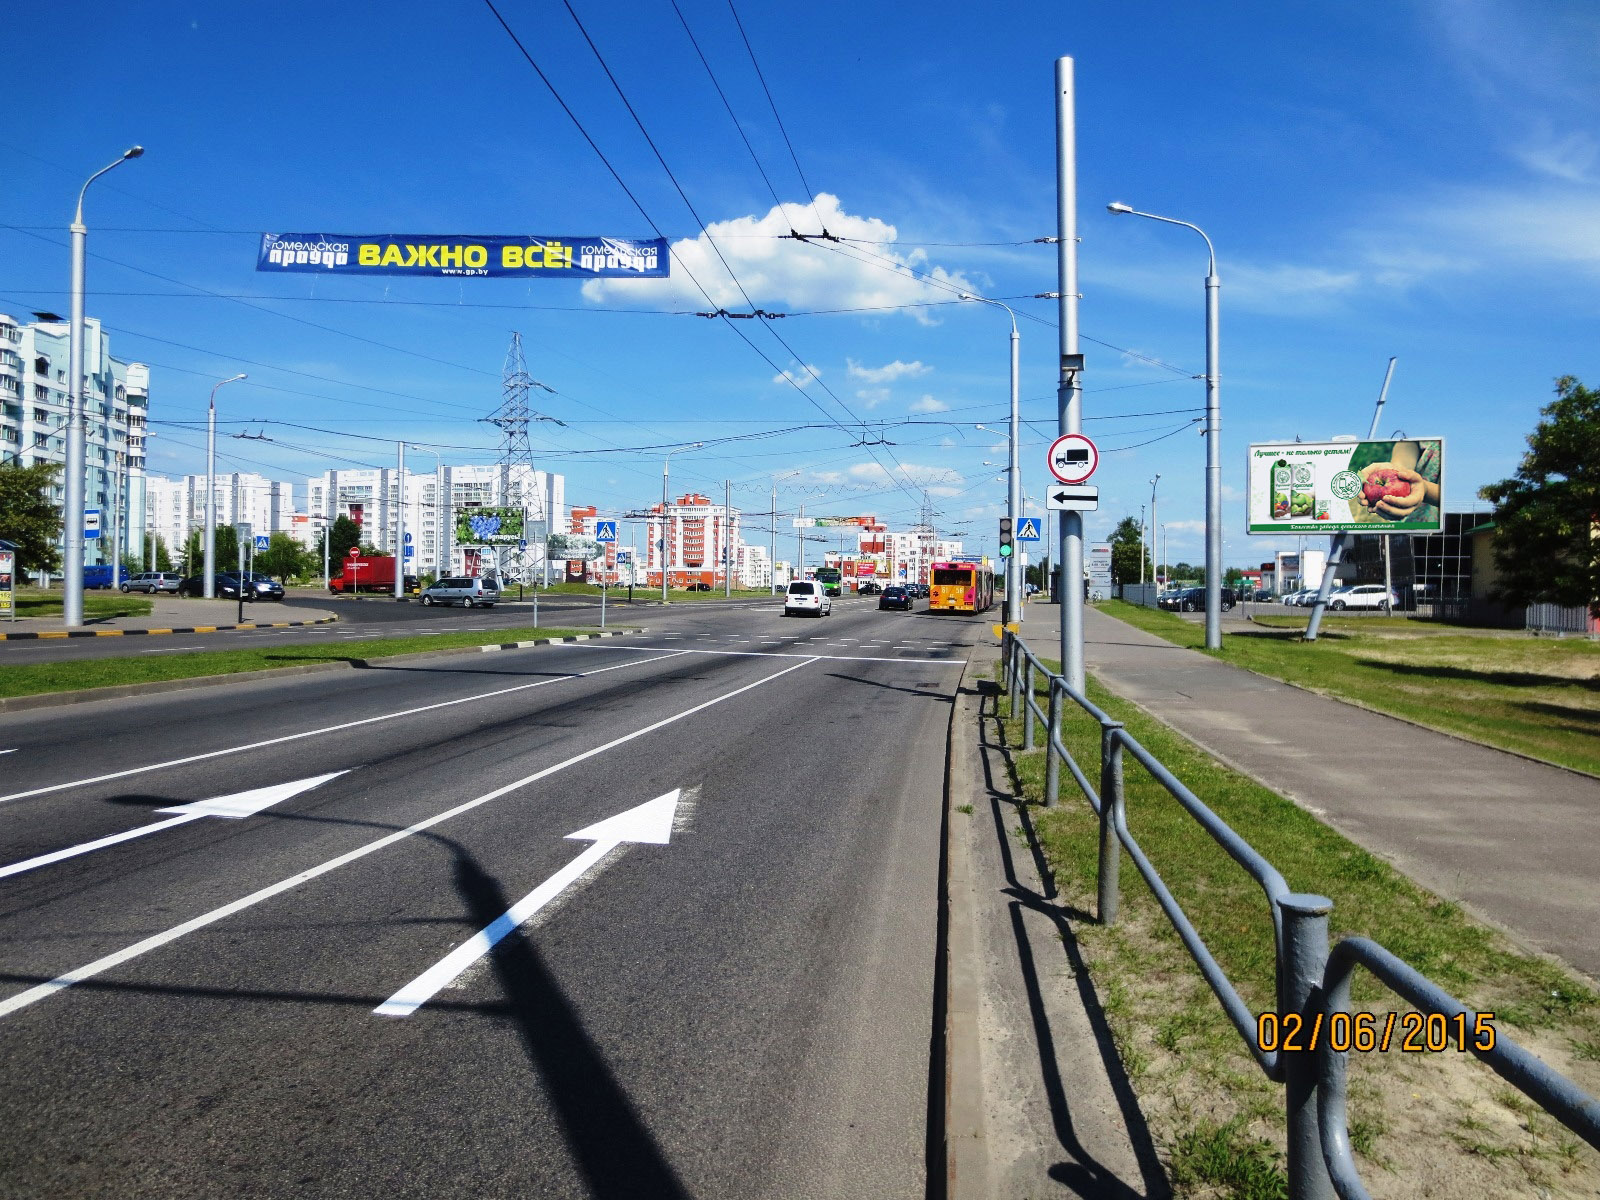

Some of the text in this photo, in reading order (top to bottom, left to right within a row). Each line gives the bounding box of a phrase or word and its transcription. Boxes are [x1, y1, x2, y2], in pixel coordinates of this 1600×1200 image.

[357, 241, 573, 269] ВАЖНО ВСЁ!
[441, 268, 489, 276] www.gp.by
[1323, 447, 1352, 457] детям!
